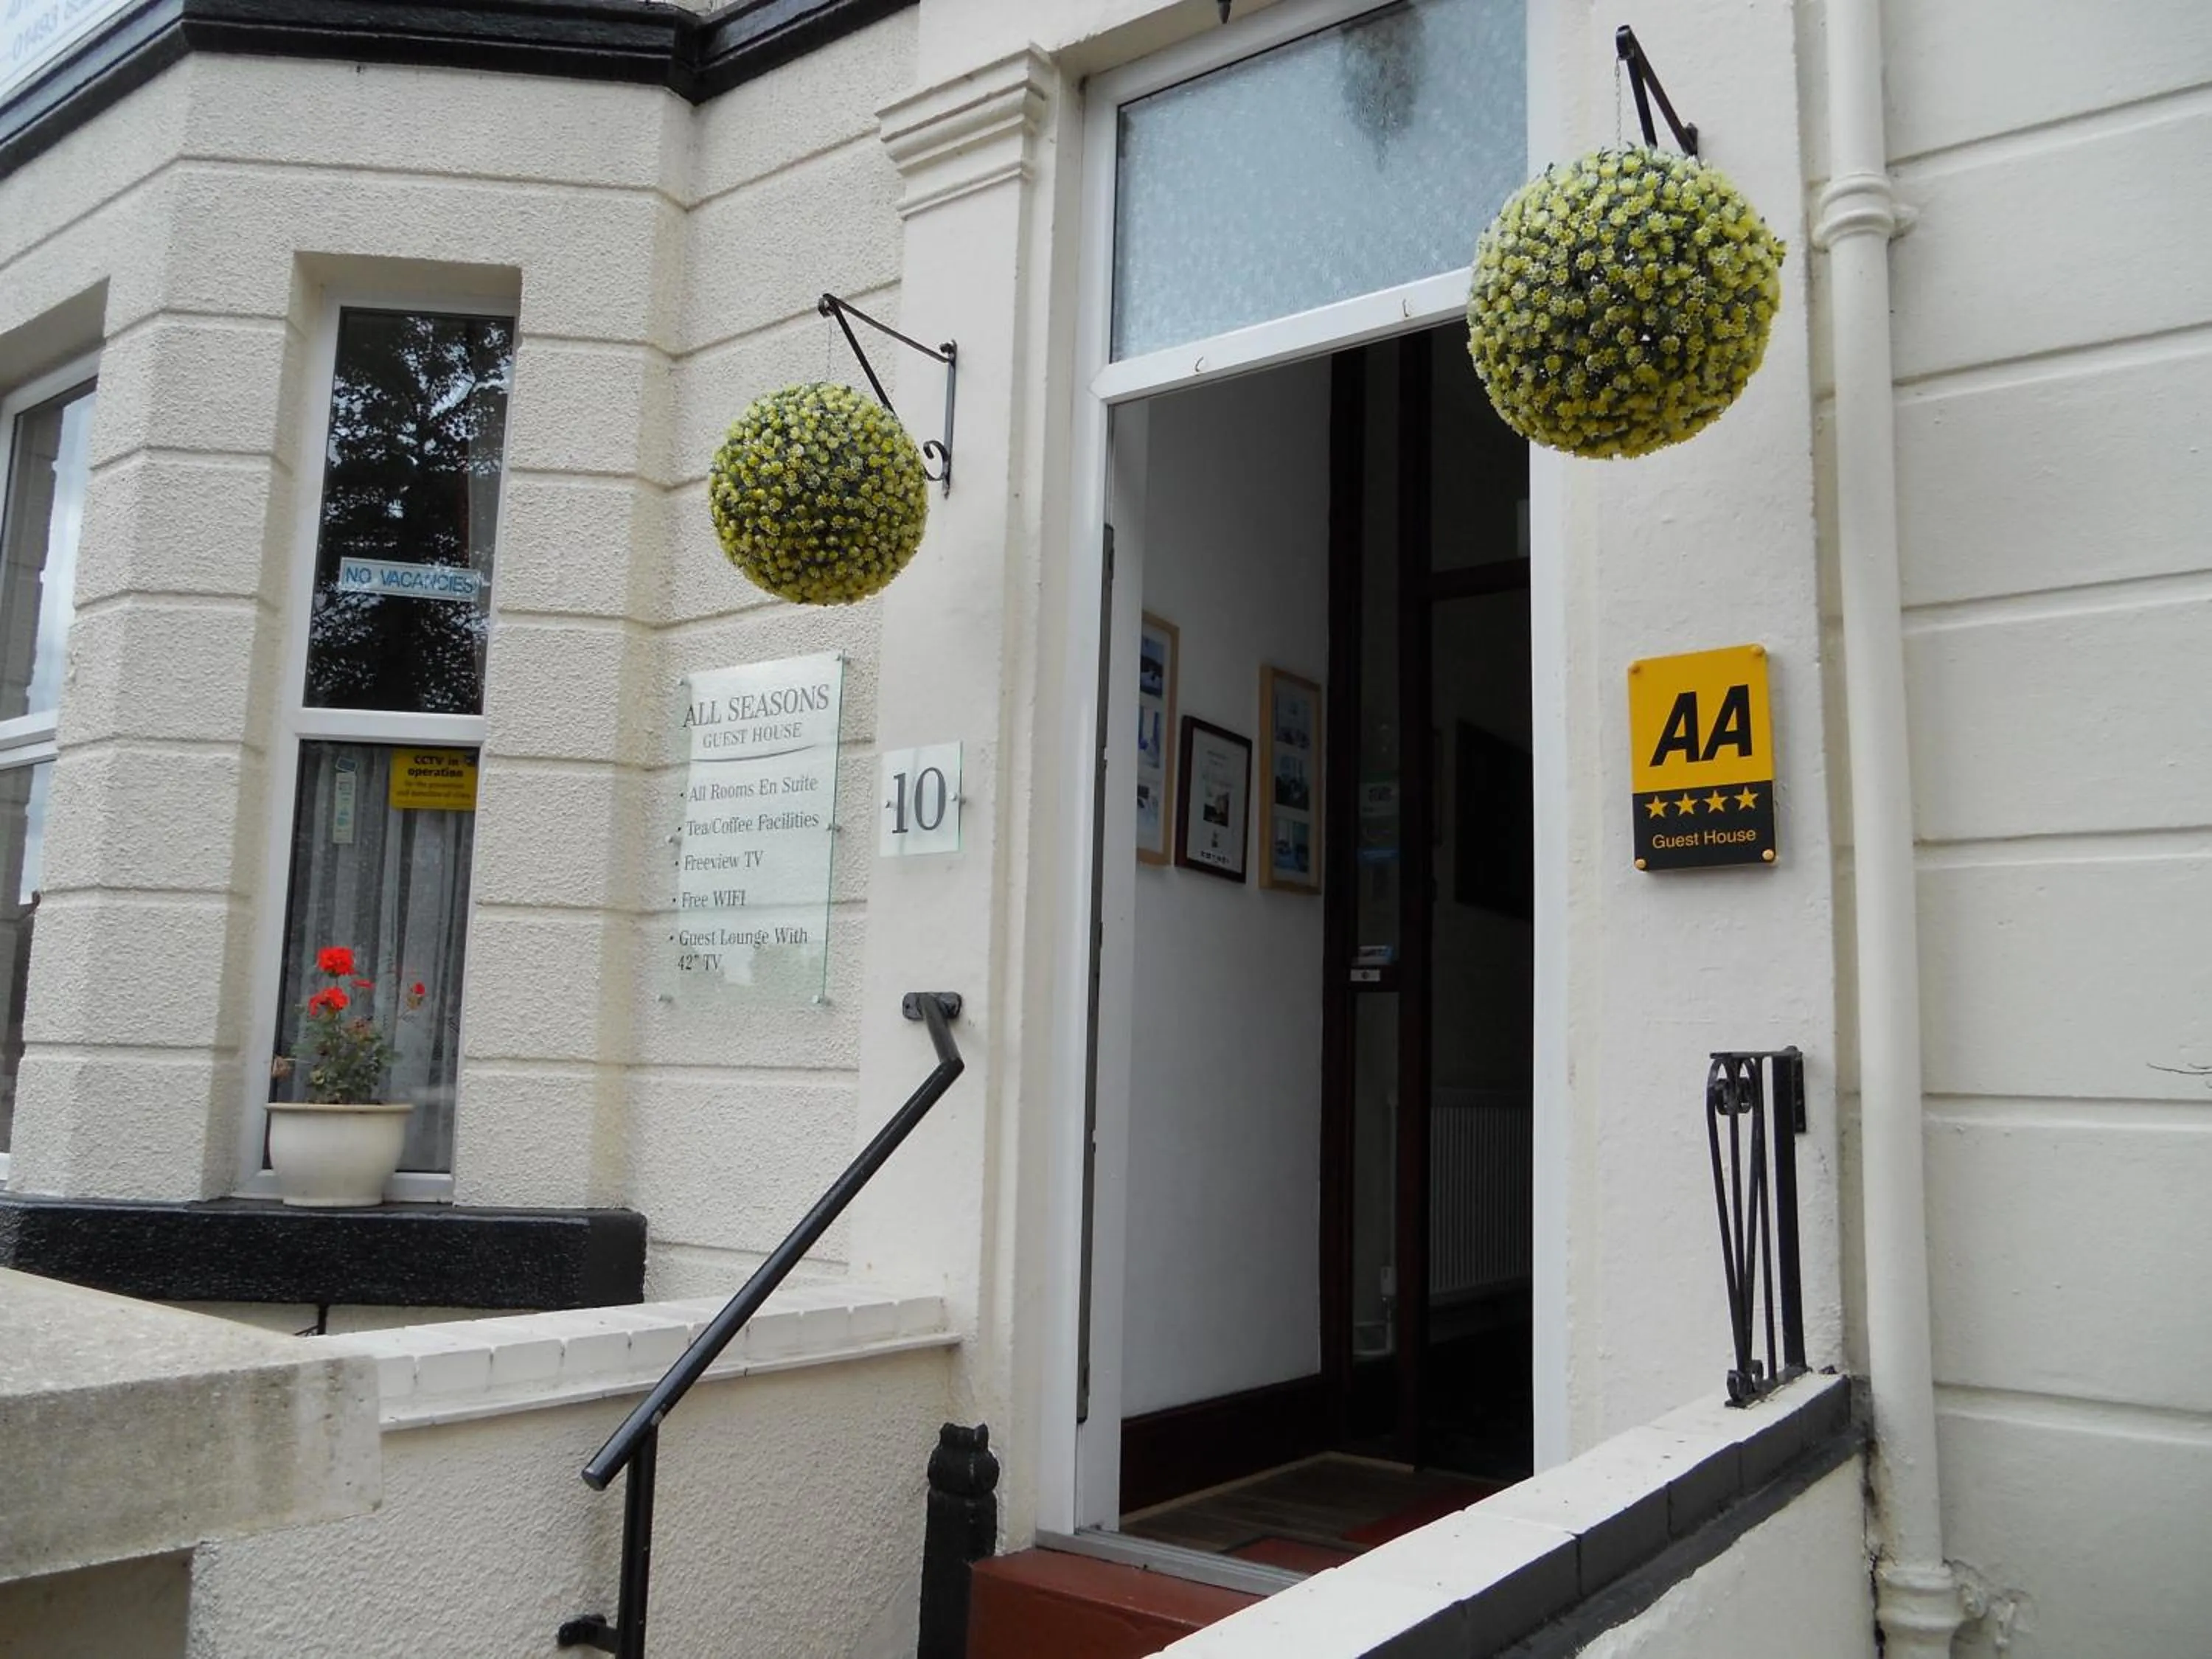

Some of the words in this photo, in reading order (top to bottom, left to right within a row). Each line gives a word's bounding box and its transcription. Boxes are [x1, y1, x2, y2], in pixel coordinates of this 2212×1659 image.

[345, 566, 372, 584] NO
[380, 568, 476, 593] VACANCIES
[683, 700, 722, 727] ALL
[728, 684, 830, 722] SEASONS
[703, 728, 748, 748] GUEST
[752, 722, 802, 743] HOUSE
[1649, 684, 1753, 767] AA
[414, 755, 444, 765] CCTV
[448, 755, 459, 765] in
[408, 768, 464, 778] operation
[689, 785, 706, 801] All
[710, 783, 754, 800] Rooms
[759, 779, 776, 796] En
[782, 775, 818, 793] Suite
[891, 767, 947, 834] 10
[686, 817, 753, 836] Tea/Coffee
[759, 811, 820, 831] Facilities
[1652, 832, 1699, 849] Guest
[1704, 828, 1756, 844] House
[684, 853, 739, 871] Freeview
[745, 850, 764, 868] TV
[682, 891, 709, 908] Free
[713, 889, 746, 906] WIFI
[679, 929, 716, 946] Guest
[720, 928, 769, 950] Lounge
[775, 926, 808, 945] With
[703, 954, 722, 971] TV
